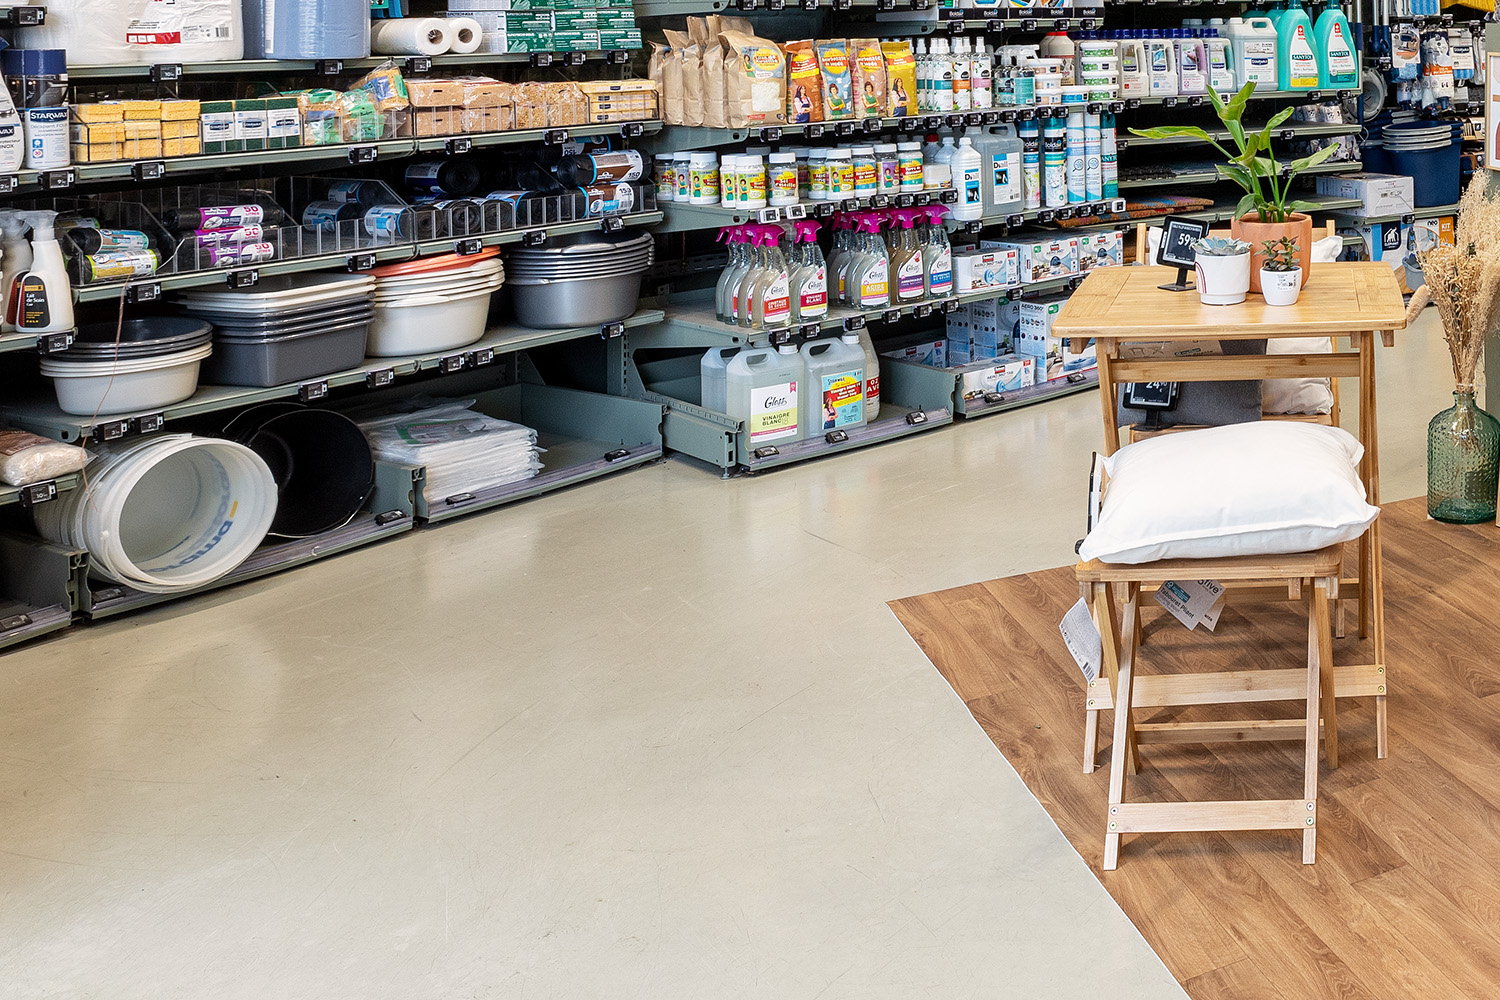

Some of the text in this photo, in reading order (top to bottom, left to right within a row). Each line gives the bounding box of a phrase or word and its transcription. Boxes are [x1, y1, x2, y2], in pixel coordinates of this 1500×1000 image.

[30, 110, 67, 121] STARWAX
[762, 412, 790, 421] VINAIGRE
[1160, 588, 1182, 607] Tabouret
[1180, 604, 1195, 619] Pliant
